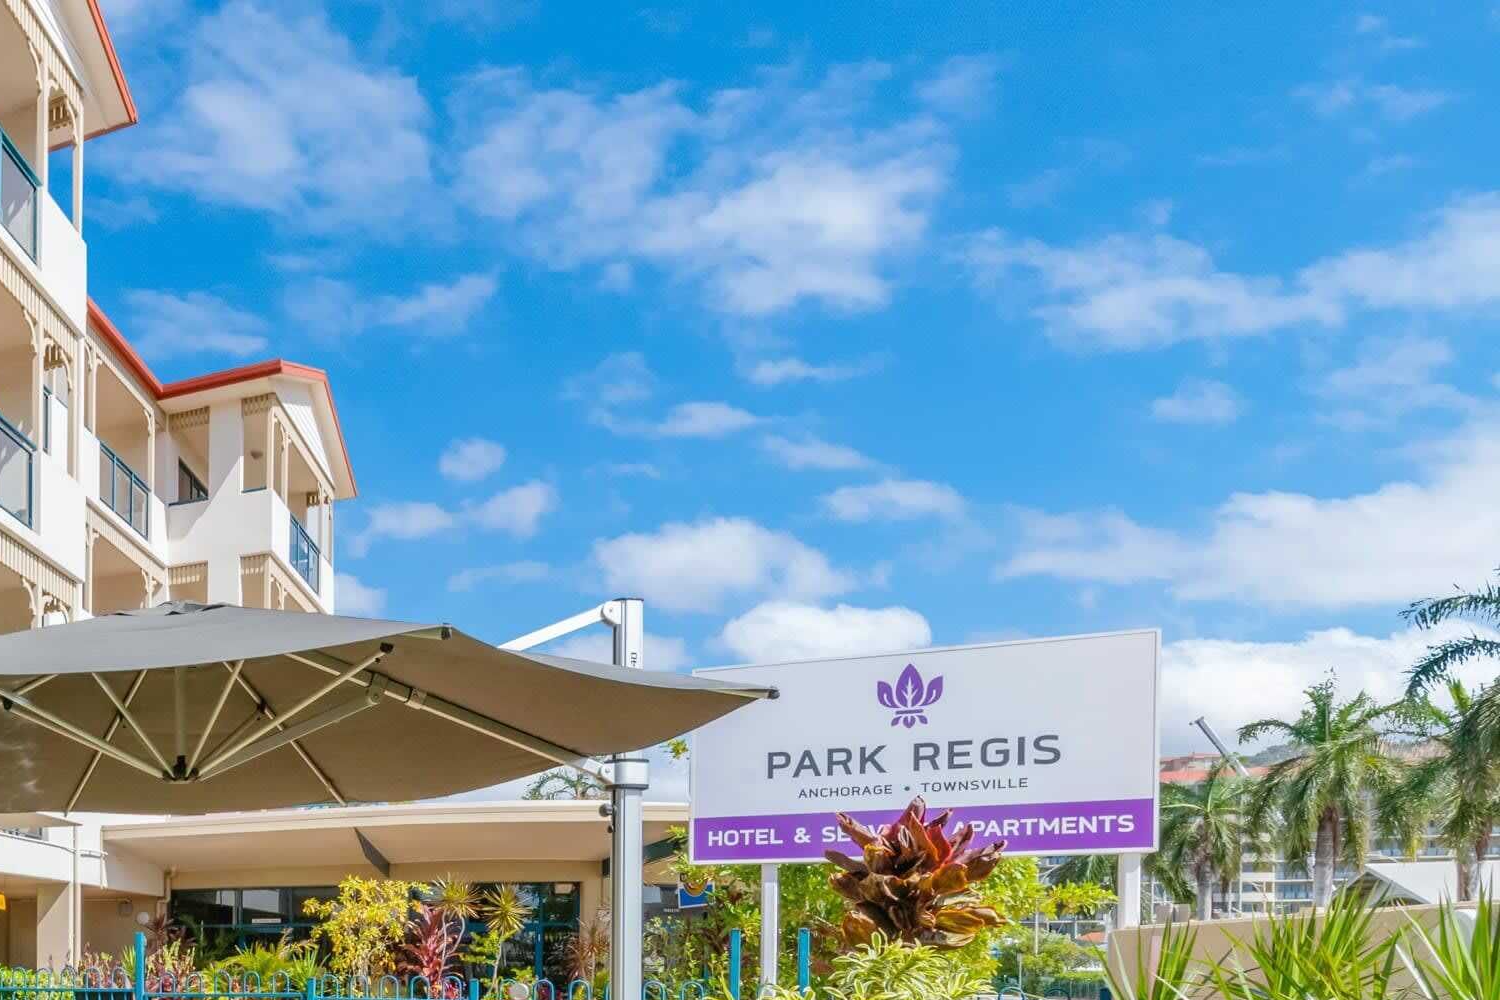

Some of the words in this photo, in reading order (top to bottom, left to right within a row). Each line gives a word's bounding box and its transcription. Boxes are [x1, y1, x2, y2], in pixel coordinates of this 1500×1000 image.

[766, 745, 888, 780] PARK
[912, 734, 1062, 772] REGIS
[798, 784, 893, 799] ANCHORAGE
[920, 777, 1029, 793] TOWNSVILLE
[707, 827, 783, 847] HOTEL
[793, 826, 811, 844] &
